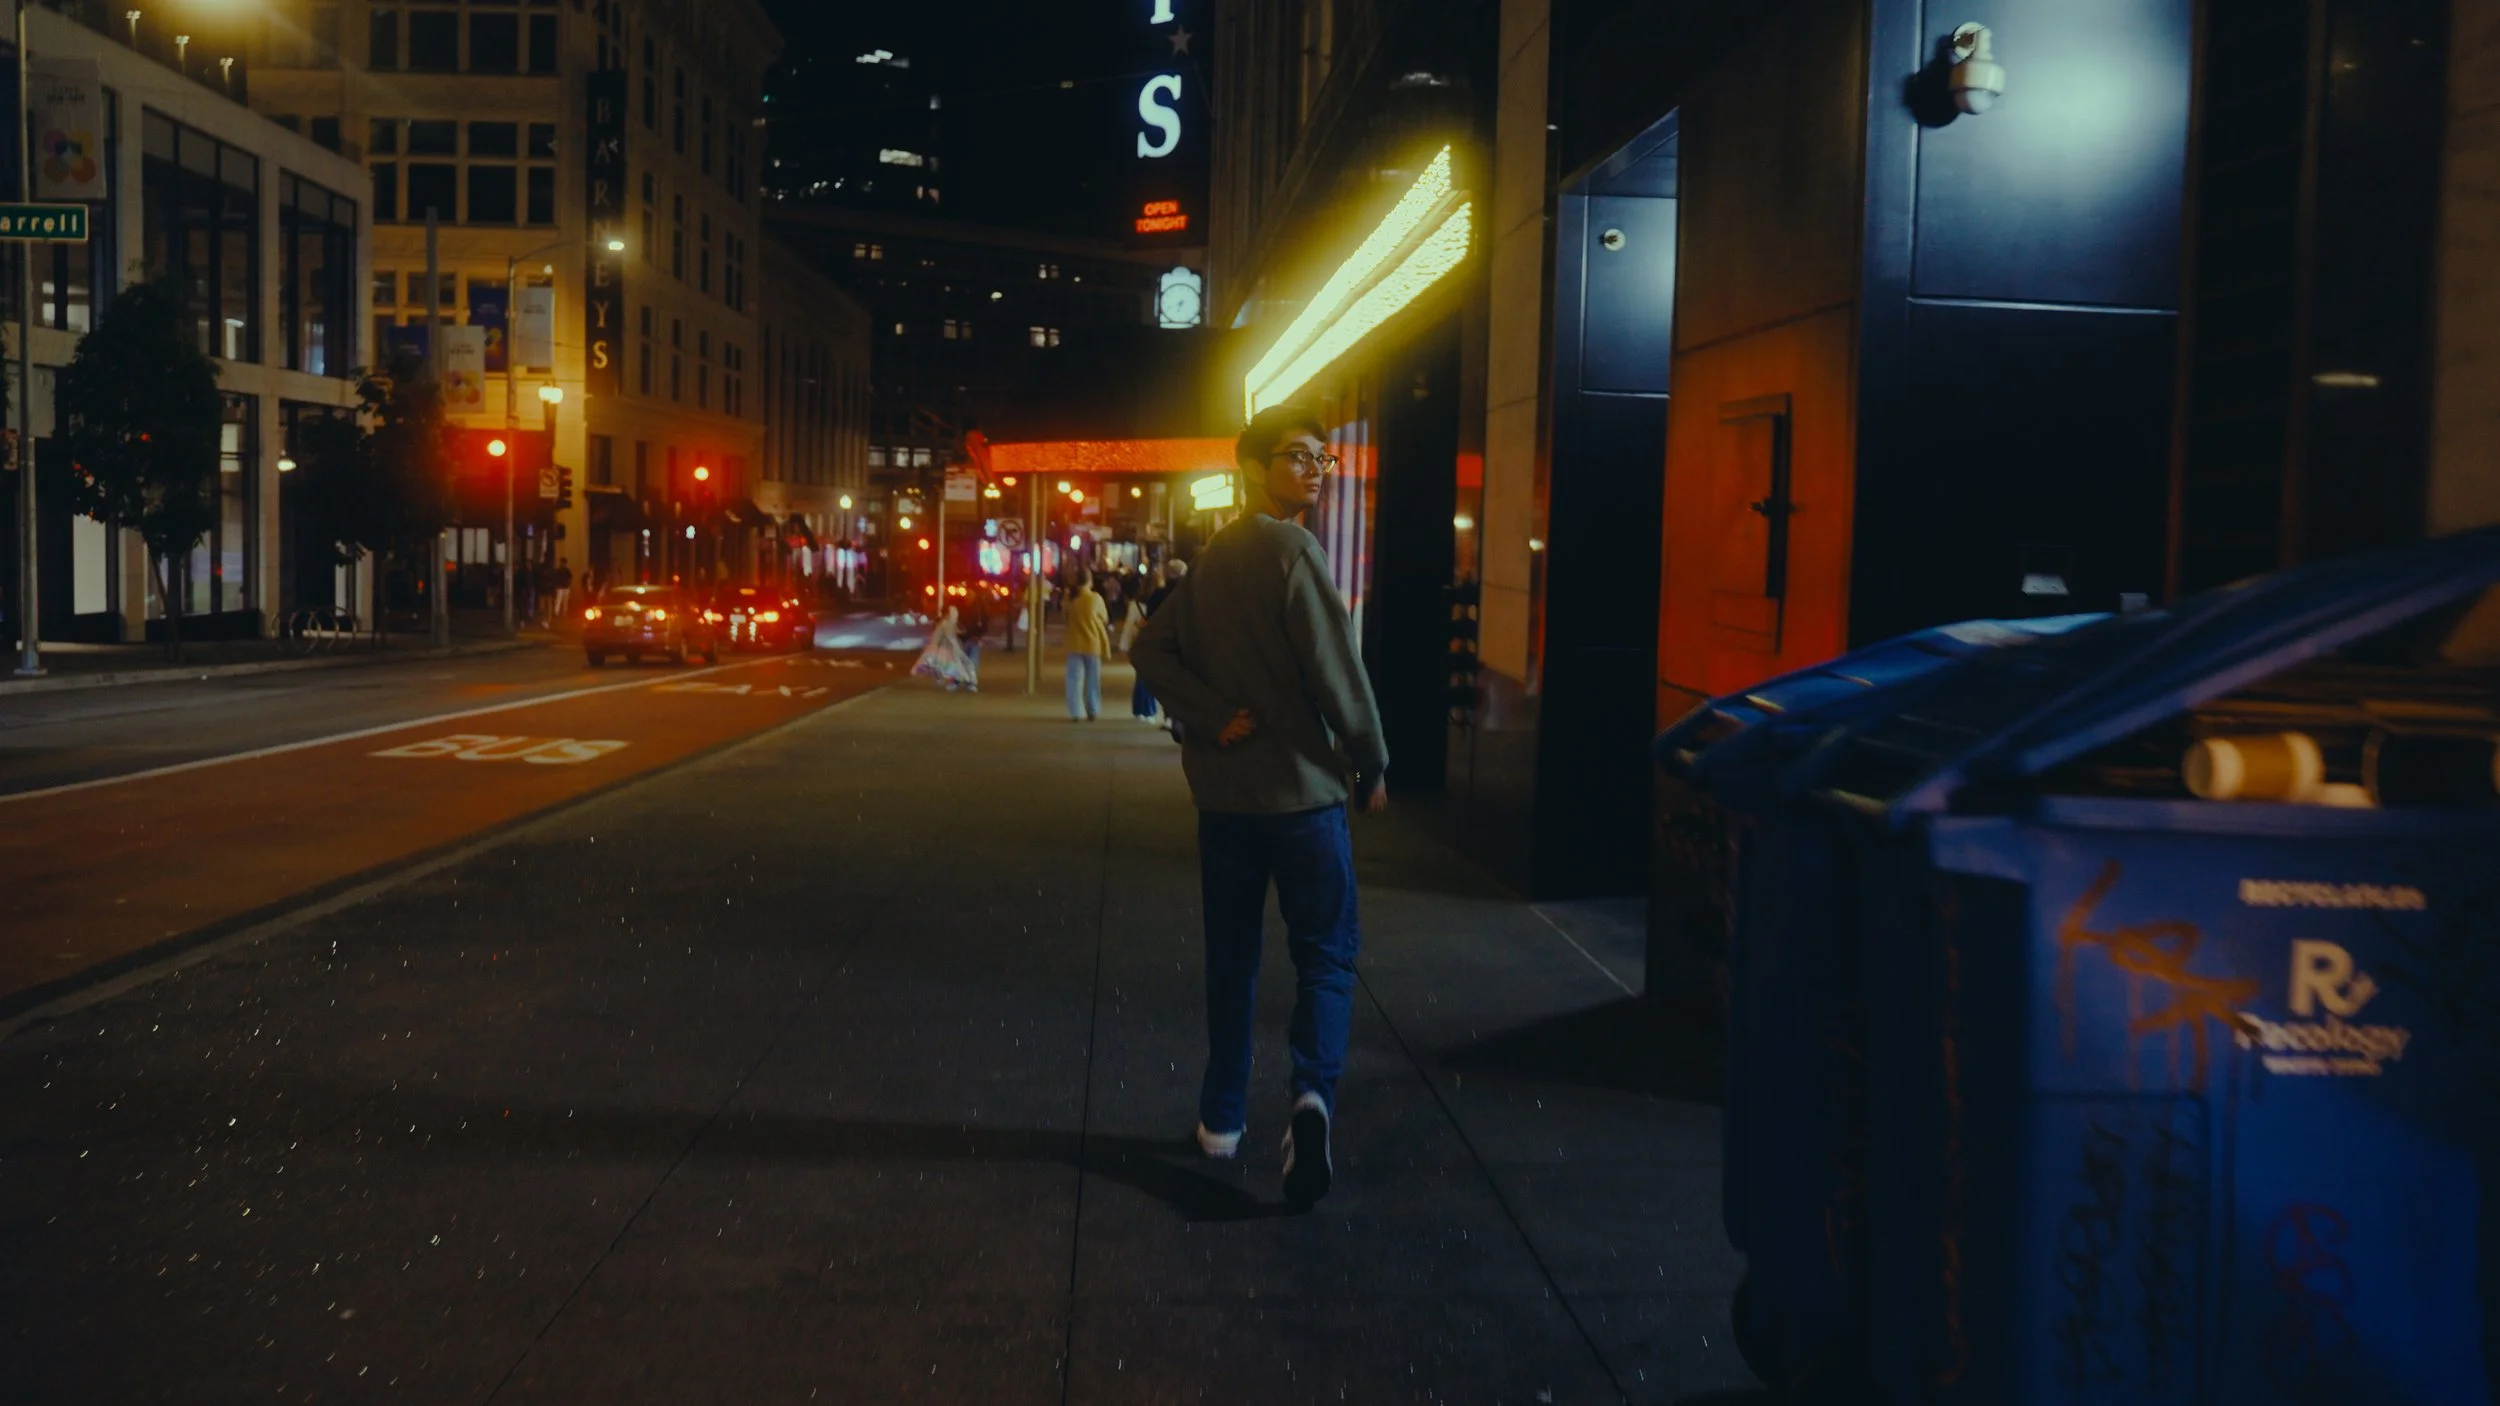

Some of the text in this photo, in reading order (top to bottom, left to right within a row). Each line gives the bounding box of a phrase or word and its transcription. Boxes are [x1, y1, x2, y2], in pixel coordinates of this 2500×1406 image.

[1143, 201, 1178, 216] OPEN
[592, 97, 612, 369] BARNEYS
[1135, 215, 1187, 232] TONIGHT
[368, 734, 629, 764] BUS
